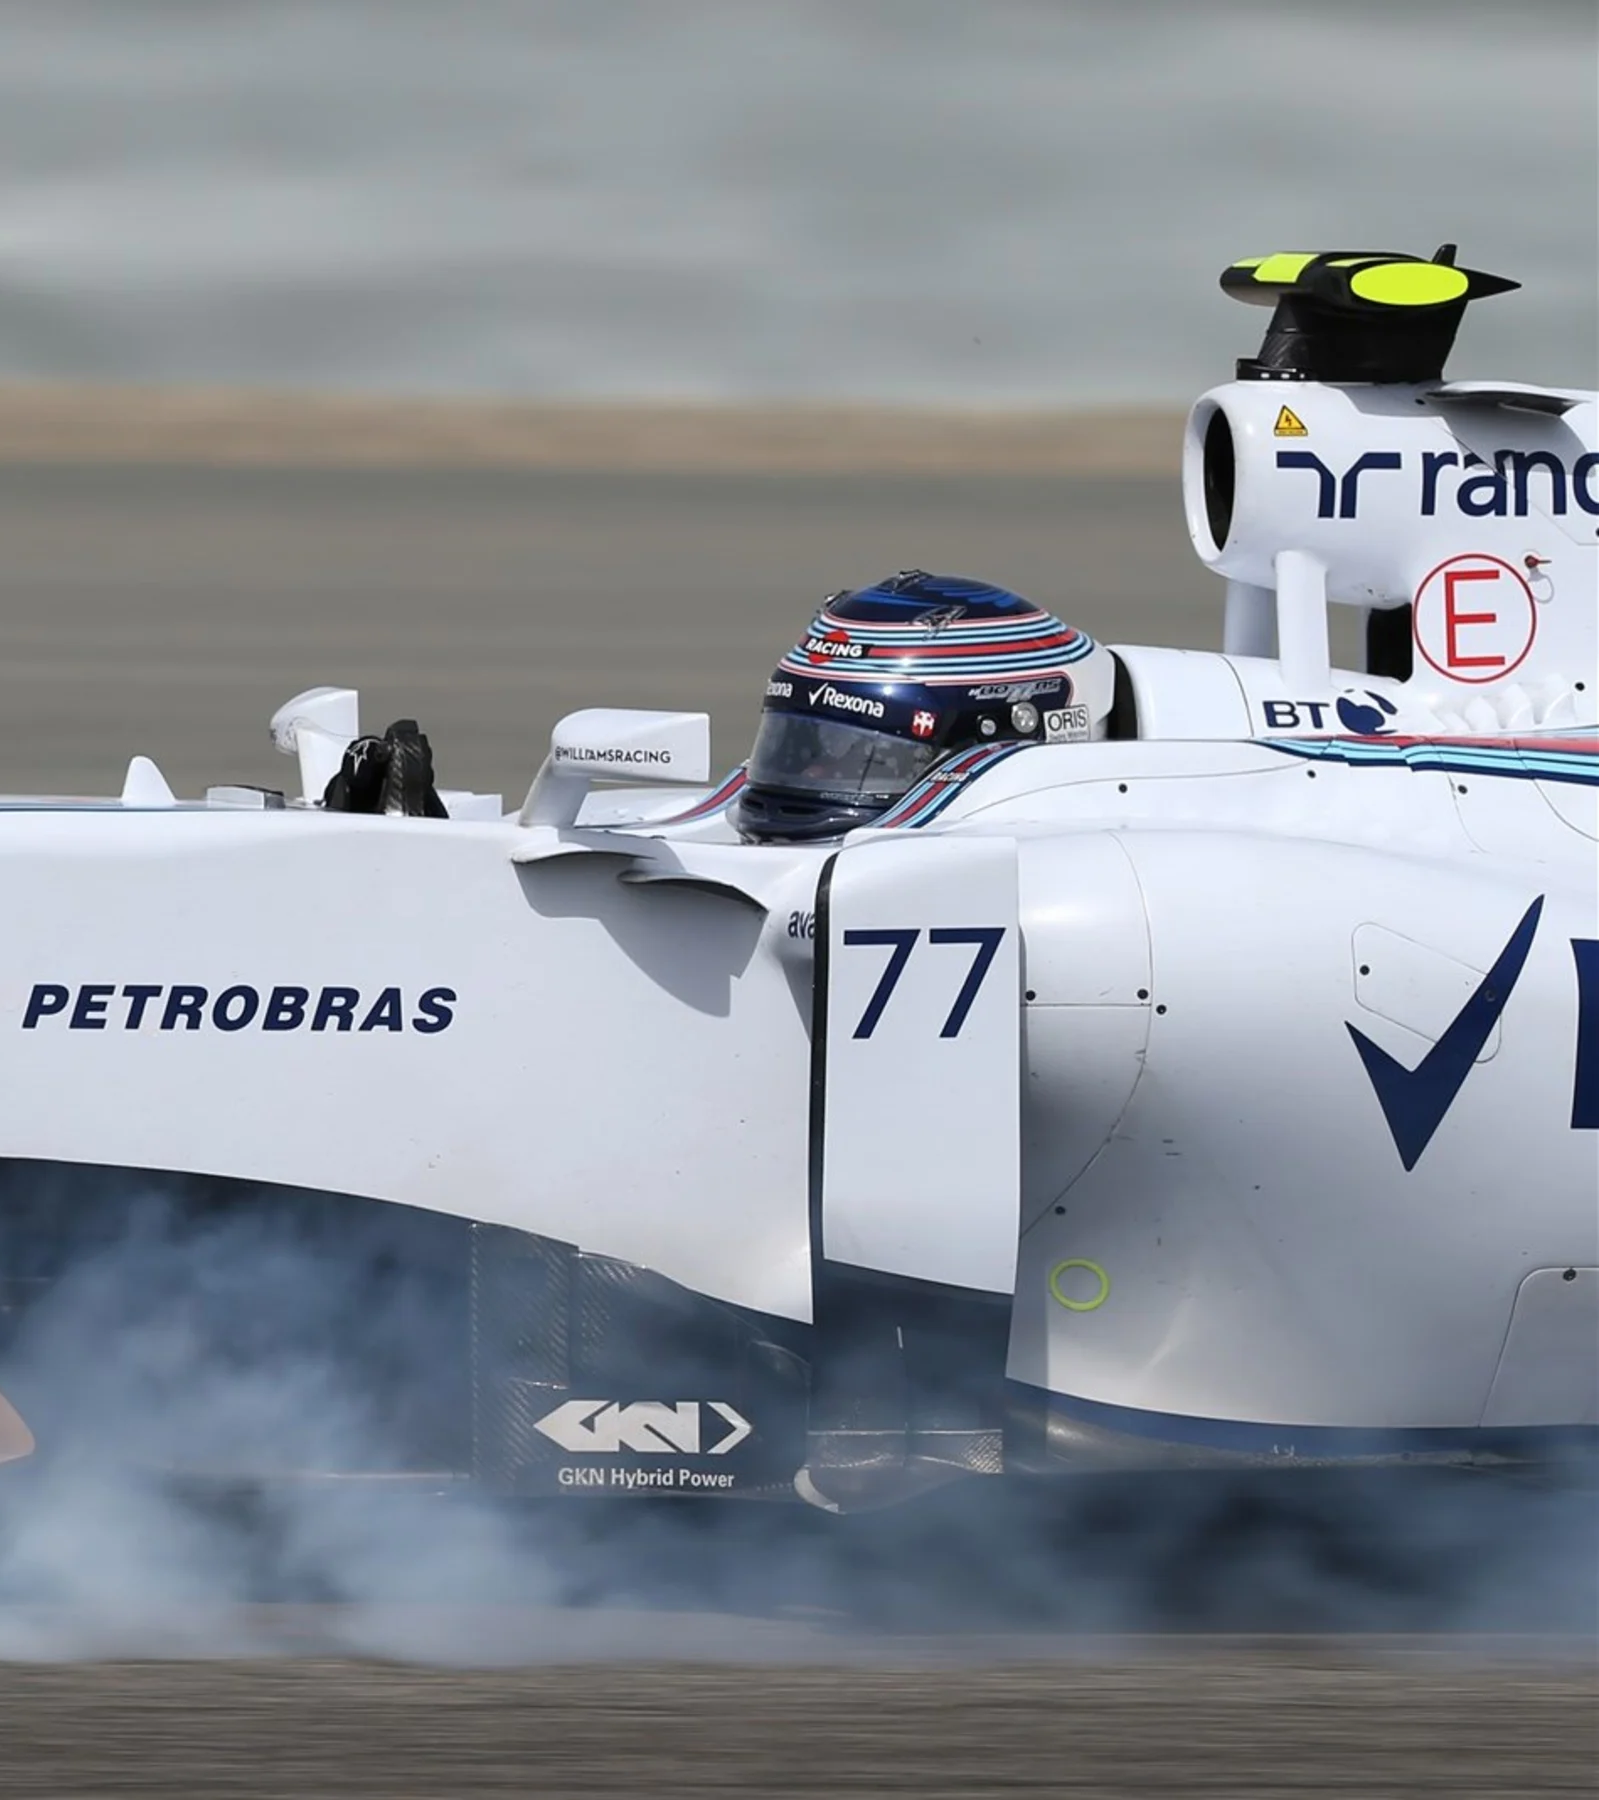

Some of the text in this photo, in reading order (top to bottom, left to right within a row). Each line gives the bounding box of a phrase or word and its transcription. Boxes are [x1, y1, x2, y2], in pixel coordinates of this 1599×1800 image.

[1444, 569, 1506, 668] E
[805, 638, 863, 657] RACING
[823, 686, 885, 718] Rexona
[1263, 700, 1331, 730] BT
[1047, 708, 1087, 732] ORIS
[843, 927, 1007, 1040] 77
[21, 984, 457, 1034] PETROBRAS
[558, 1467, 735, 1489] GKN Hybrid Power
